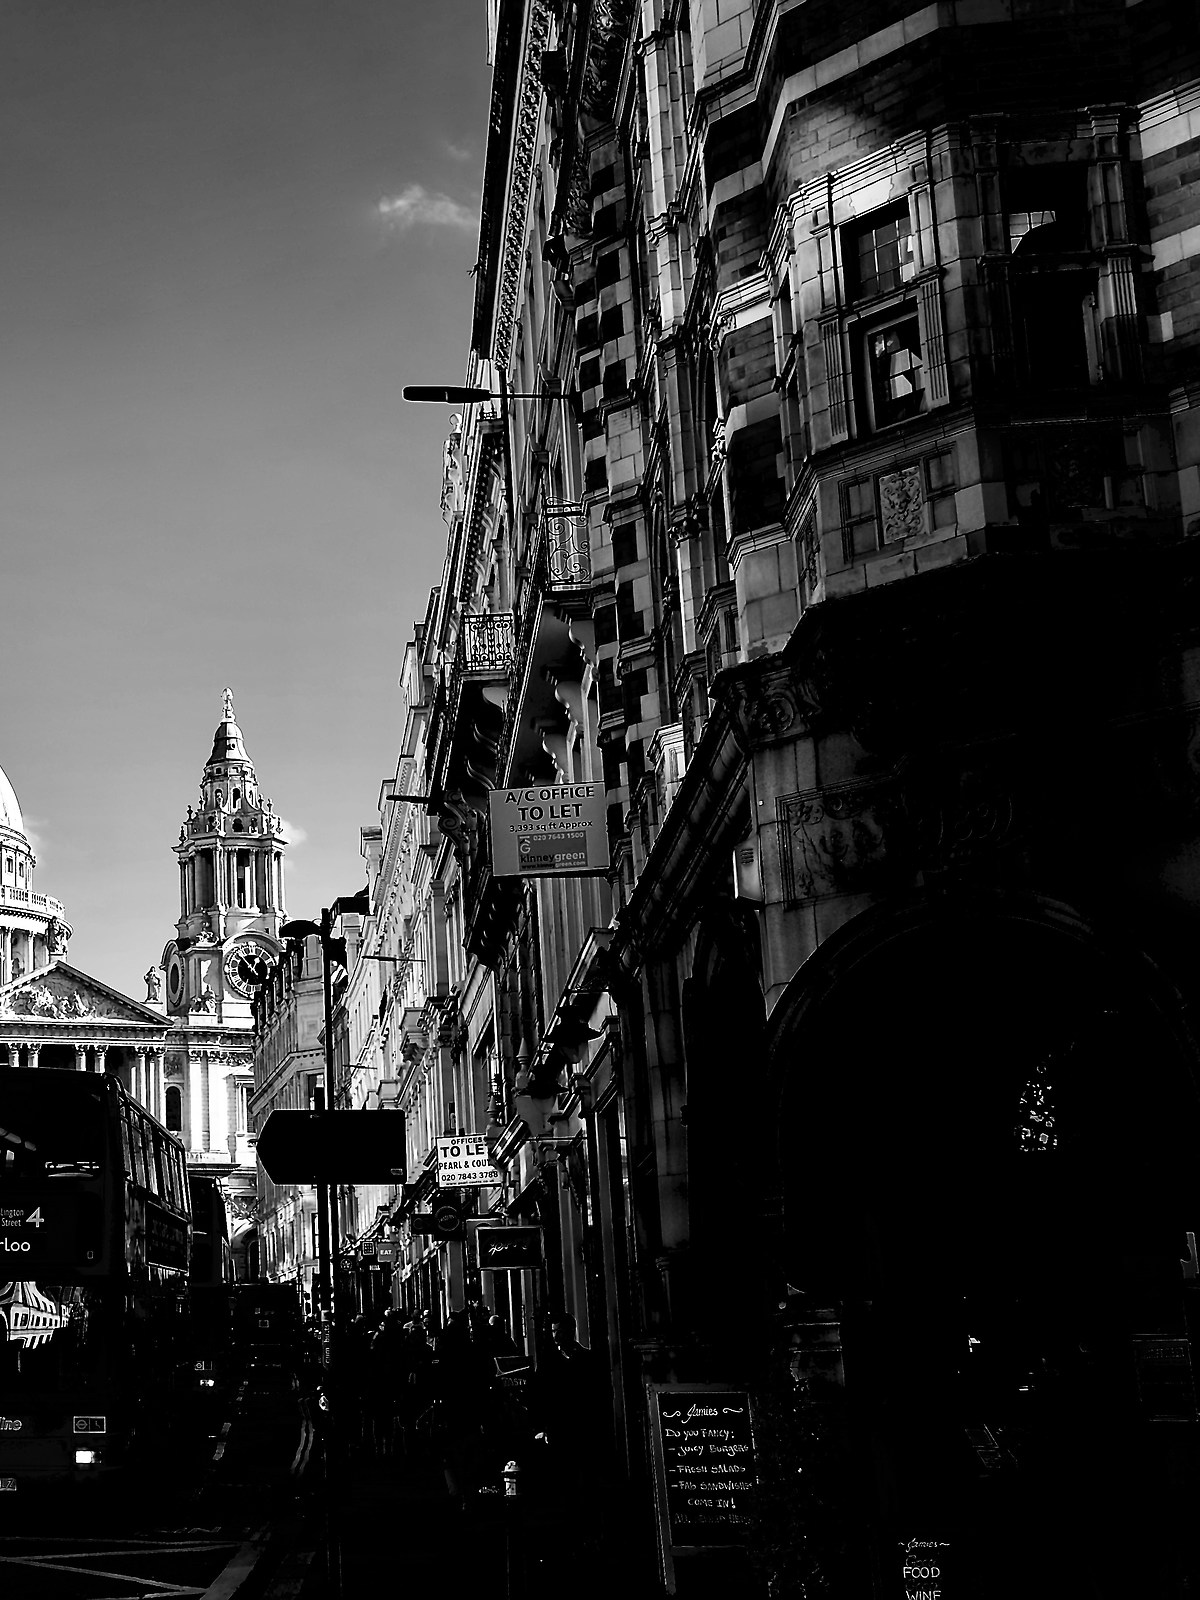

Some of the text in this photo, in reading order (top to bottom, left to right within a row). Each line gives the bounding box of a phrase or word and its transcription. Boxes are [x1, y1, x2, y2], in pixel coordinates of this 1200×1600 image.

[505, 786, 594, 805] A/C OFFICE
[518, 803, 582, 821] TO LET
[509, 823, 534, 833] 3,393
[548, 821, 557, 829] ft
[559, 820, 593, 830] Approx
[533, 833, 546, 841] 020
[567, 831, 584, 839] 1500
[520, 851, 586, 863] kinneygreen
[450, 1136, 483, 1145] OFFICES
[440, 1143, 488, 1158] TO LE
[439, 1161, 462, 1170] PEARL
[464, 1160, 470, 1169] &
[458, 1172, 477, 1180] 7843
[1, 1218, 22, 1227] Street
[26, 1206, 45, 1228] 4
[681, 1404, 719, 1424] Jamies
[665, 1428, 681, 1437] Do
[683, 1430, 699, 1441] you
[688, 1498, 713, 1507] COME
[903, 1566, 941, 1579] FOOD
